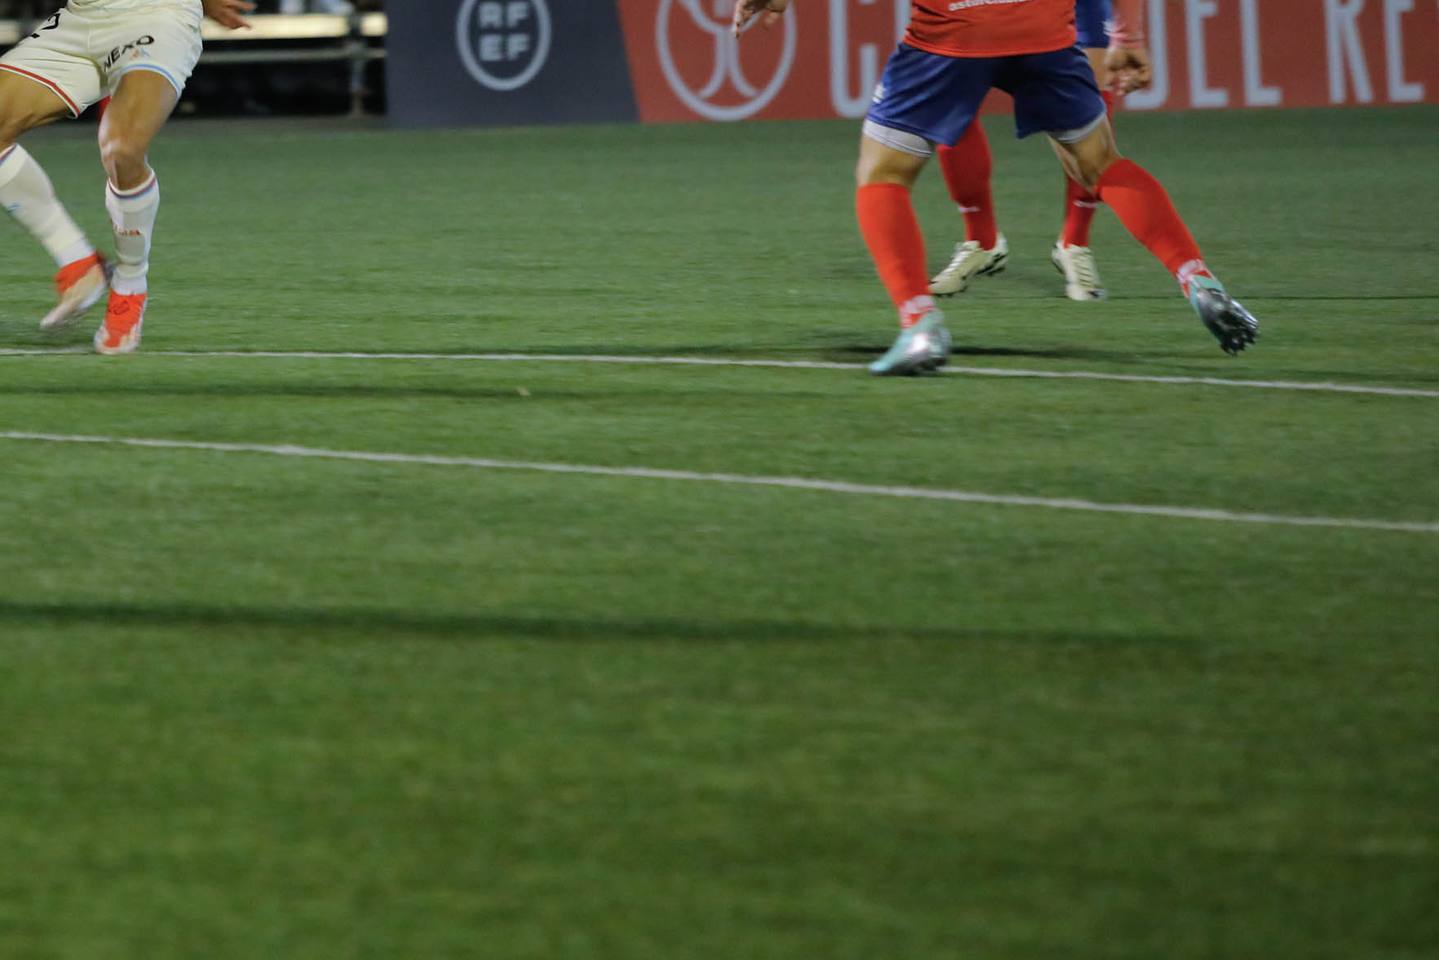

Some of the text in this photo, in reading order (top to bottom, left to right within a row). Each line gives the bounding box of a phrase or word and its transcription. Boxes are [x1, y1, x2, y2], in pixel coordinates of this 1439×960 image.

[478, 0, 529, 29] RF
[103, 35, 155, 73] NEXO
[478, 32, 529, 61] EF
